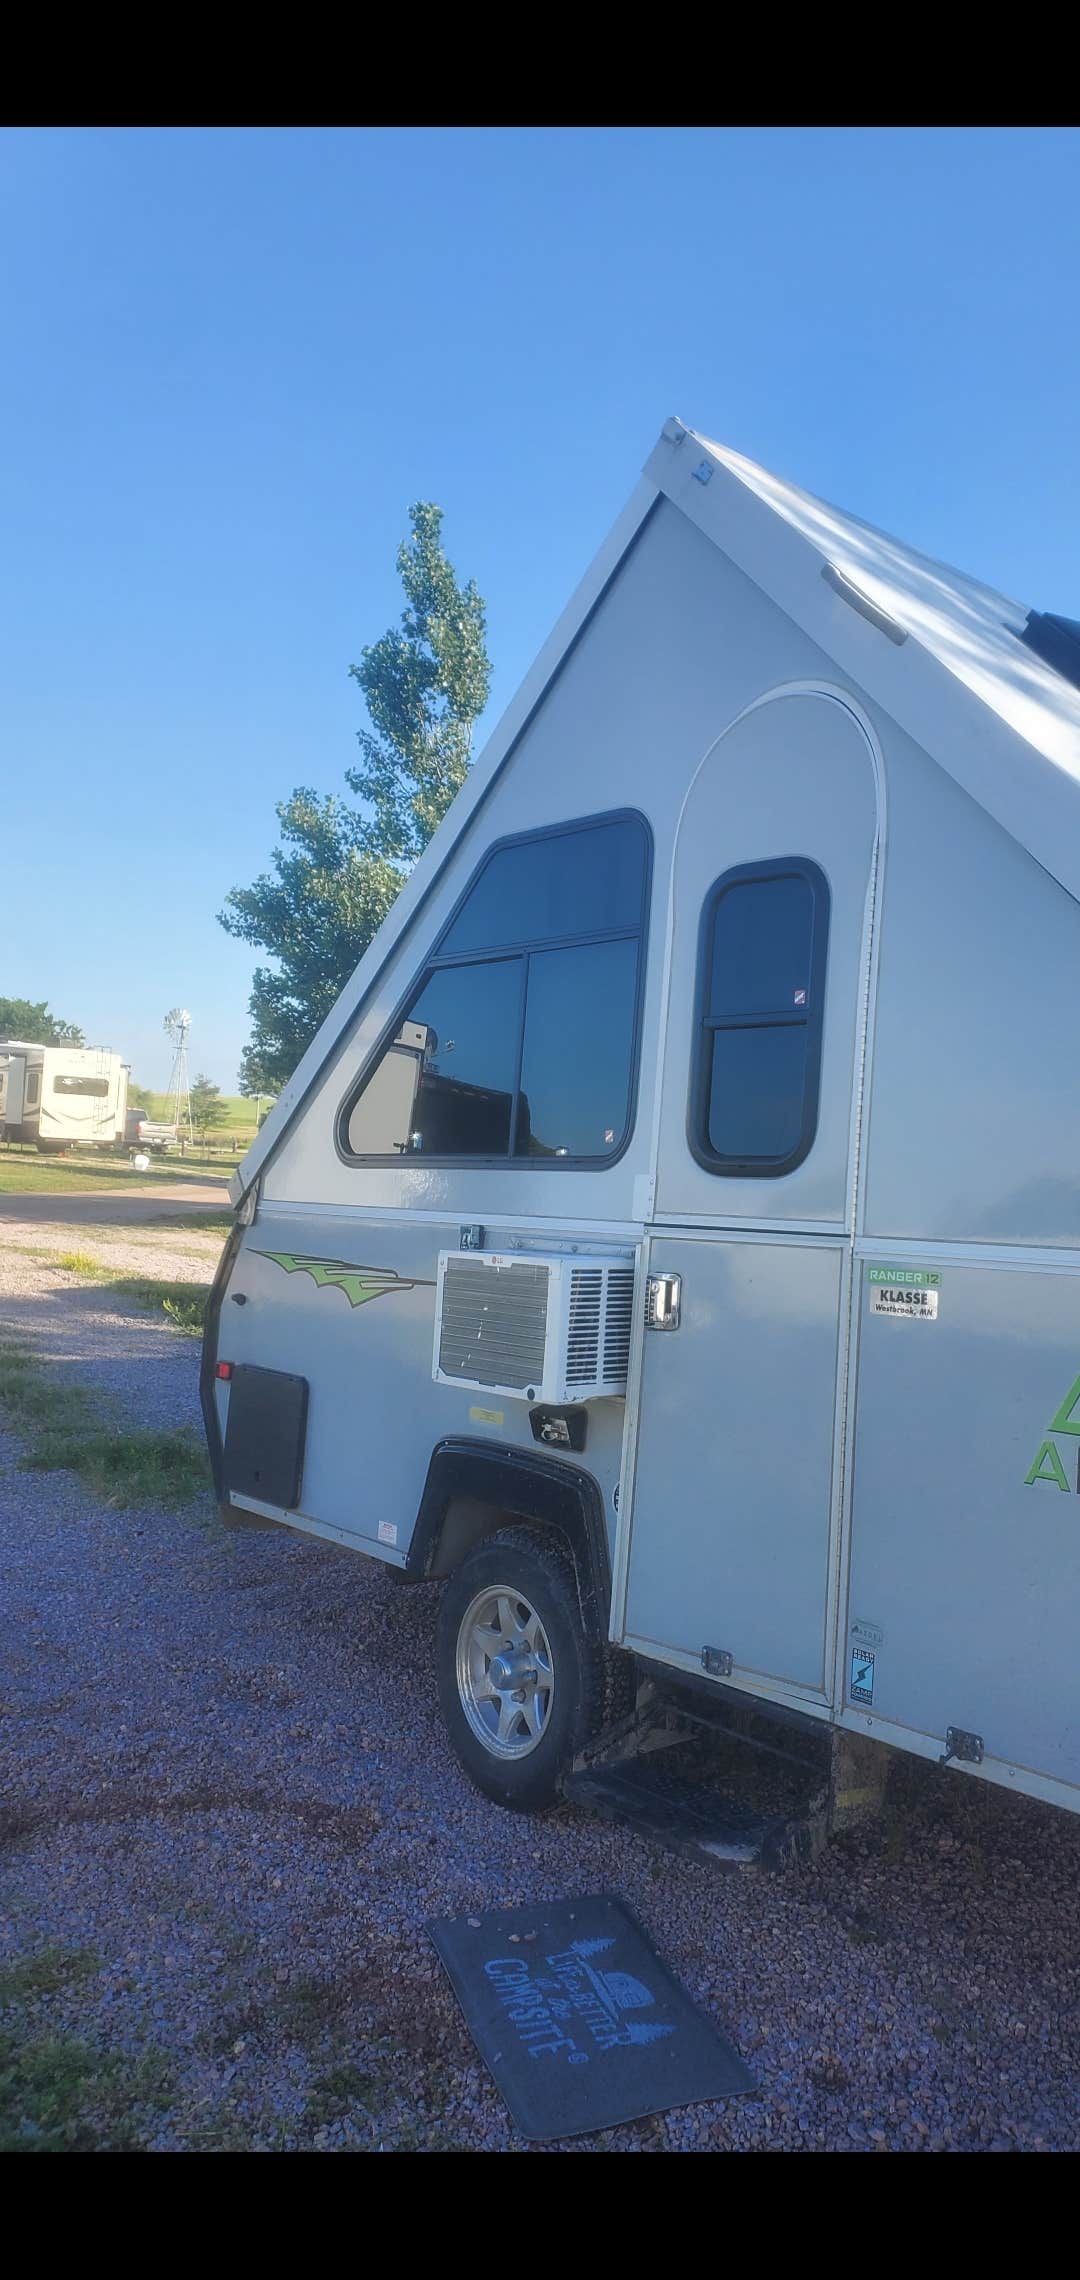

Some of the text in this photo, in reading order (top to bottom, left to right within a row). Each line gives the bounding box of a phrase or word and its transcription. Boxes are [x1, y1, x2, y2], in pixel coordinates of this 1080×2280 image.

[870, 1270, 939, 1285] RANGER 12
[880, 1289, 928, 1305] KLASSE
[875, 1304, 933, 1317] Westbrook, MN
[571, 1991, 632, 2050] BETTER
